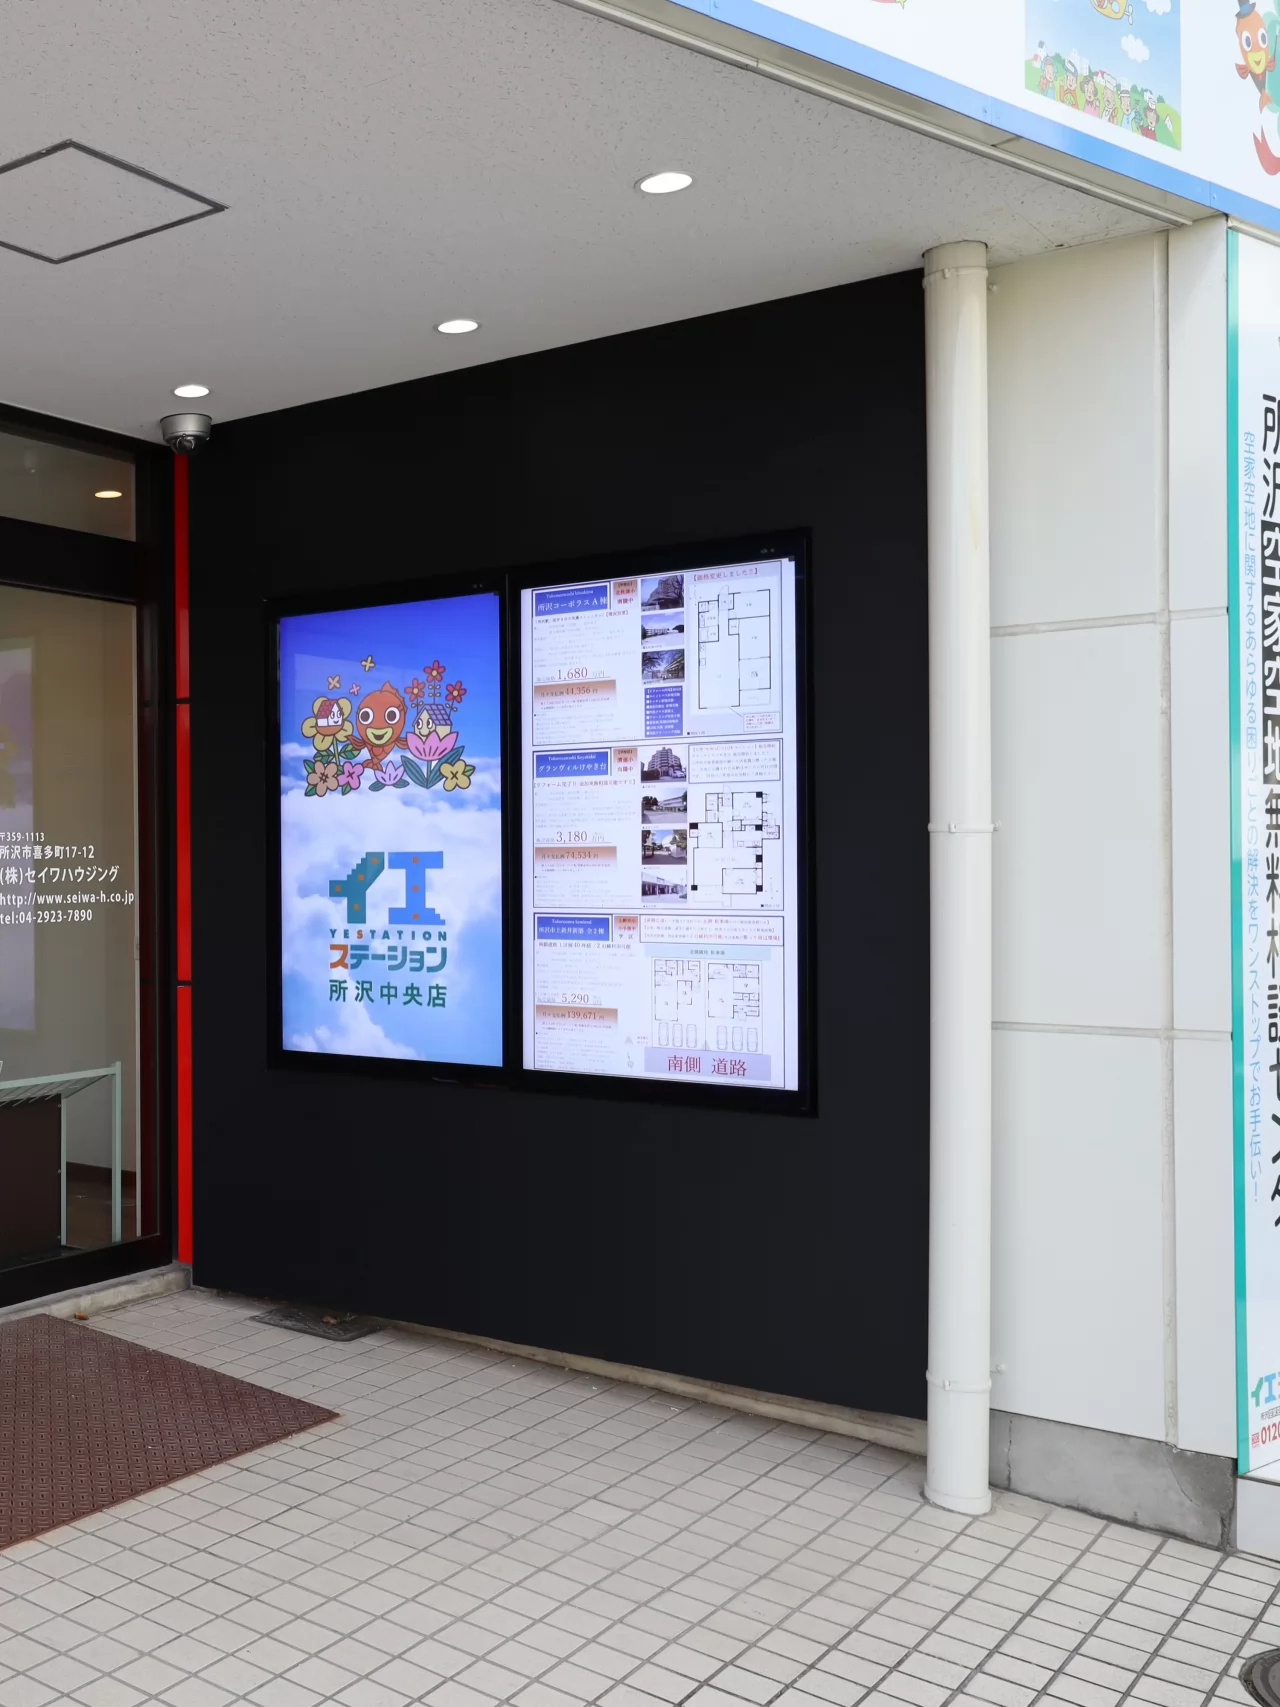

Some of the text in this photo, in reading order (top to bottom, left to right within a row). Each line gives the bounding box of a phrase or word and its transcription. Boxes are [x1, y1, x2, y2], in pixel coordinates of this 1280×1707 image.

[557, 667, 588, 681] 1,680
[565, 686, 591, 696] 44,356
[538, 762, 607, 773] グランヴィルけやき台
[0, 832, 45, 842] 〒359-1113
[556, 830, 588, 844] 3,180
[0, 845, 95, 860] 所沢市喜多町17-12
[565, 851, 592, 860] 74,534
[0, 865, 120, 886] (株)セイワハウジング
[0, 889, 135, 908] http://www.seiwa-h.co.jp
[0, 909, 93, 925] tel:04-2923-7890
[329, 929, 447, 941] YESTATION
[330, 944, 447, 973] ステーション
[329, 979, 447, 1008] 所沢中央店
[561, 993, 589, 1004] 5,290
[567, 1011, 597, 1020] 139,671
[668, 1055, 747, 1077] 南側 道路
